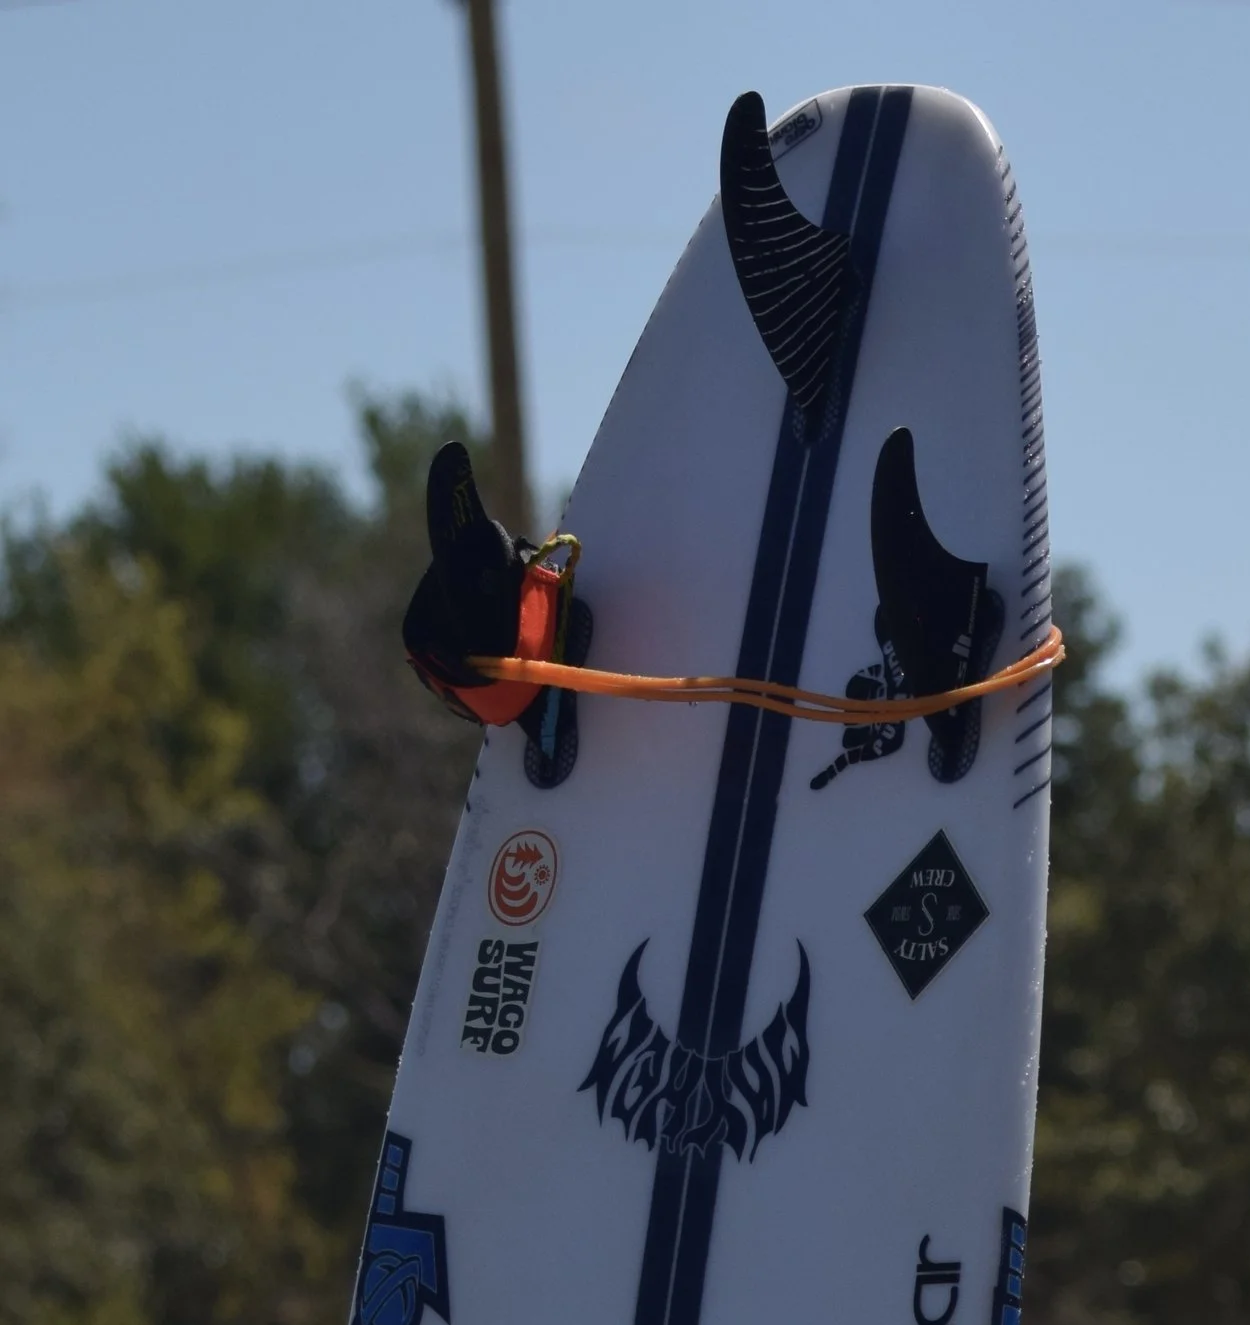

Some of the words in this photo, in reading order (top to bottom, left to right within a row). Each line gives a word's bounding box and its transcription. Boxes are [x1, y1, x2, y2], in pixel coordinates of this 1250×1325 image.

[910, 868, 956, 889] CREW
[893, 936, 949, 961] SALTY
[460, 939, 505, 1053] SURF
[491, 941, 539, 1055] WACO
